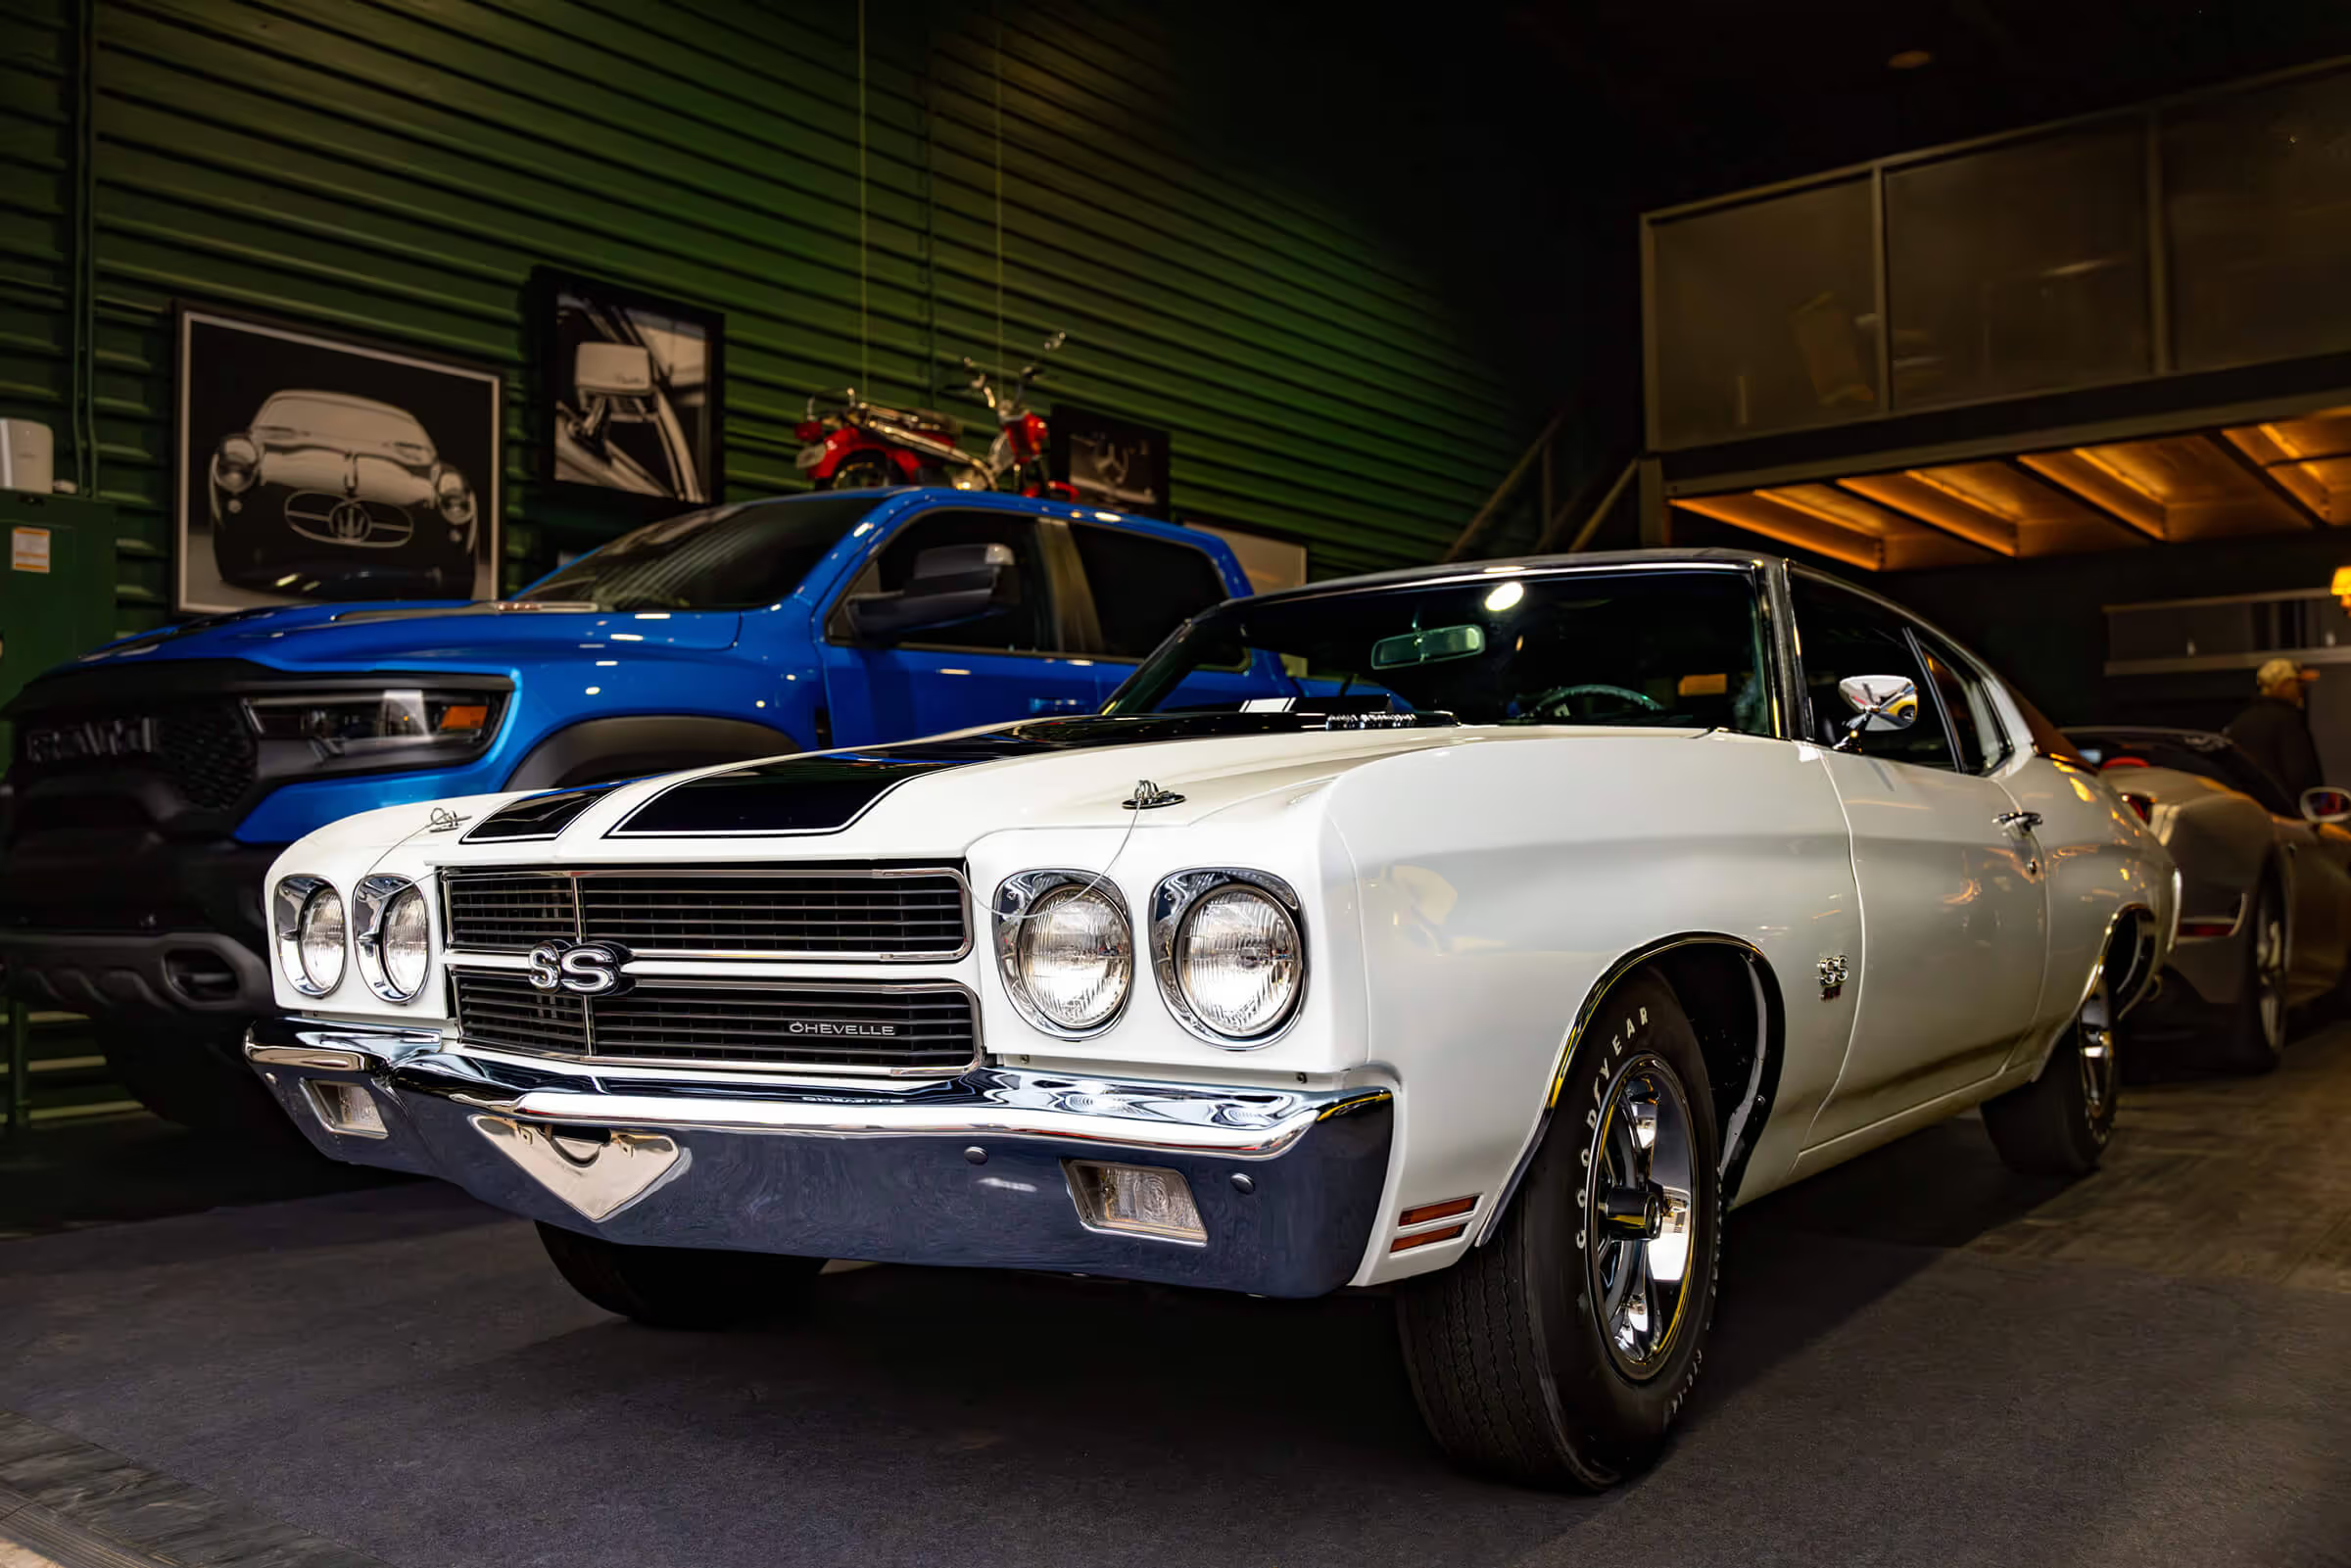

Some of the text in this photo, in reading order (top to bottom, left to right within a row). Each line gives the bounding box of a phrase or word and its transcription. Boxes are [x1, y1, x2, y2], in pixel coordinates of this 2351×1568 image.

[529, 945, 615, 992] SS
[1819, 955, 1848, 984] SS
[790, 1022, 895, 1035] CHEVELLE
